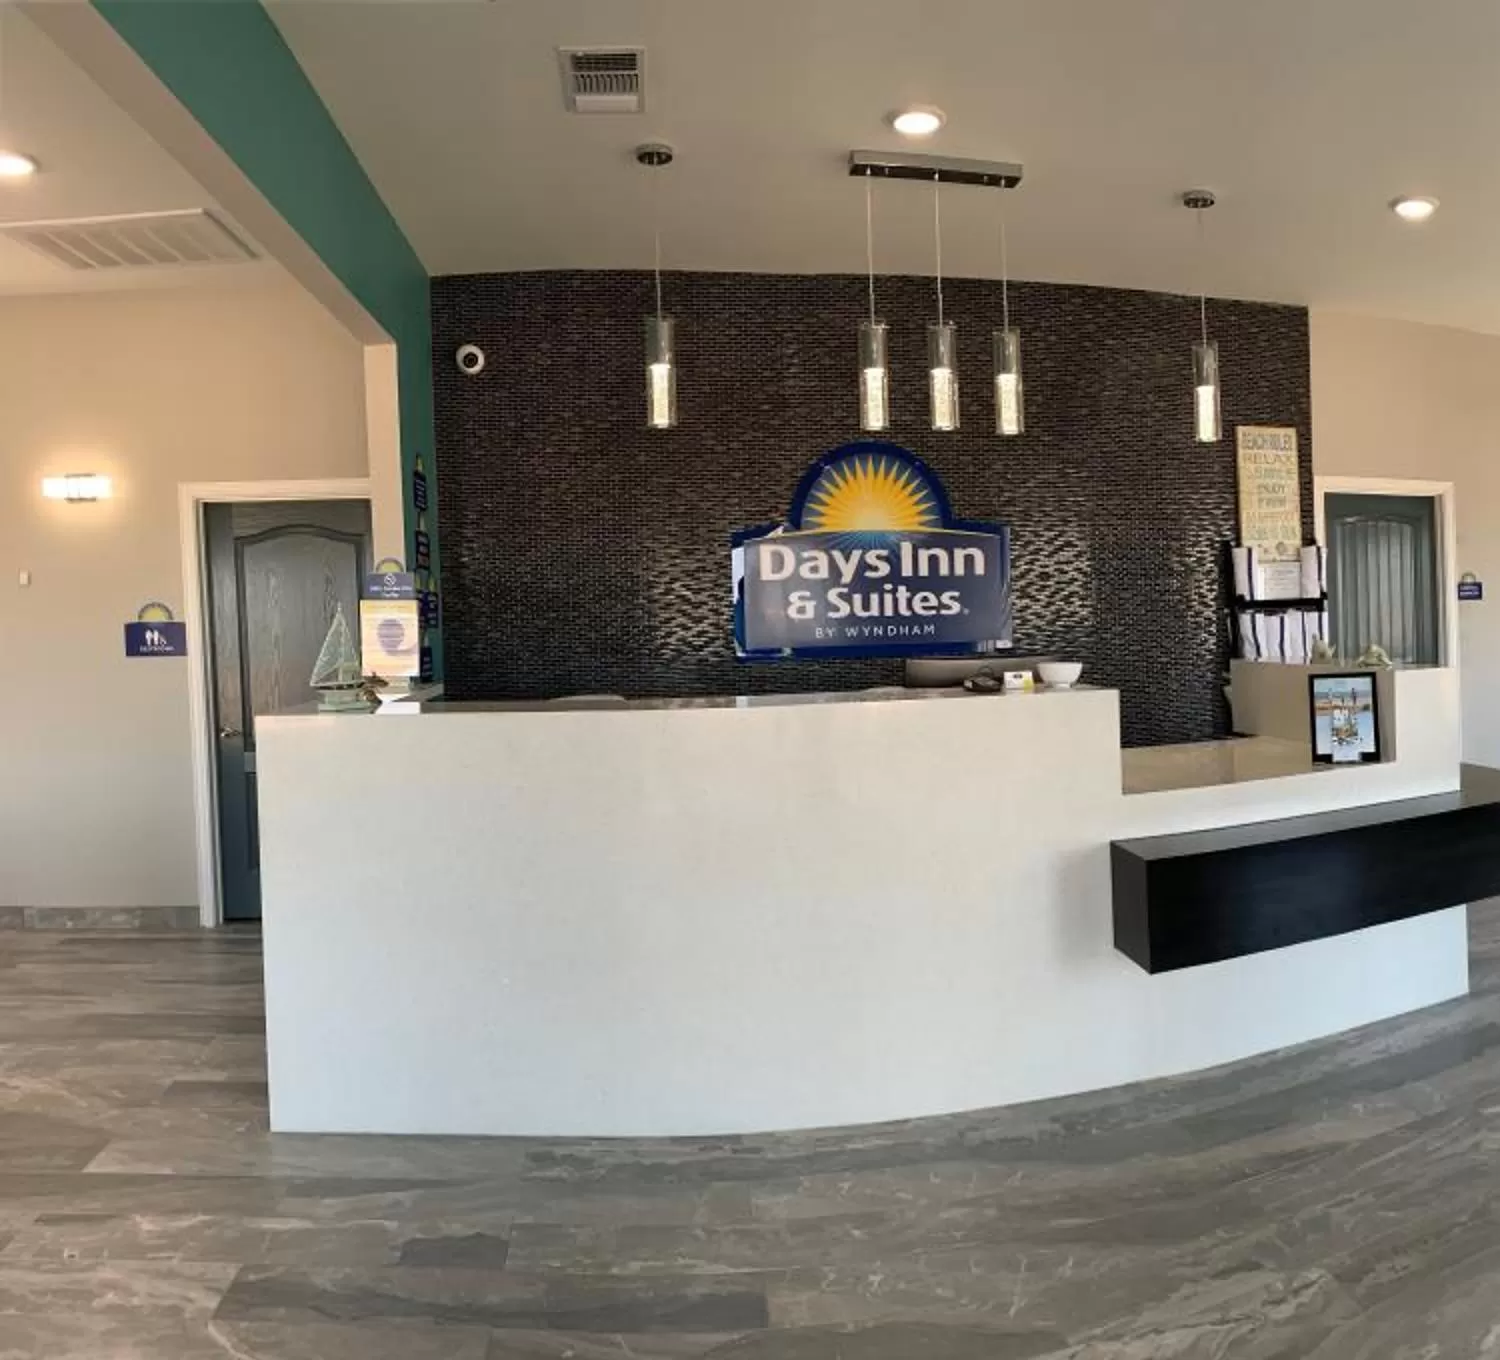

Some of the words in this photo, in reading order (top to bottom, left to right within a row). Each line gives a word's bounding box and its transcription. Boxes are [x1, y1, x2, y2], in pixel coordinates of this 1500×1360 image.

[1242, 452, 1295, 465] RELAX
[758, 543, 891, 584] Days
[901, 541, 986, 577] Inn
[787, 590, 817, 619] &
[827, 583, 961, 618] Suites
[816, 627, 835, 638] BY
[845, 625, 935, 637] WYNDHAM
